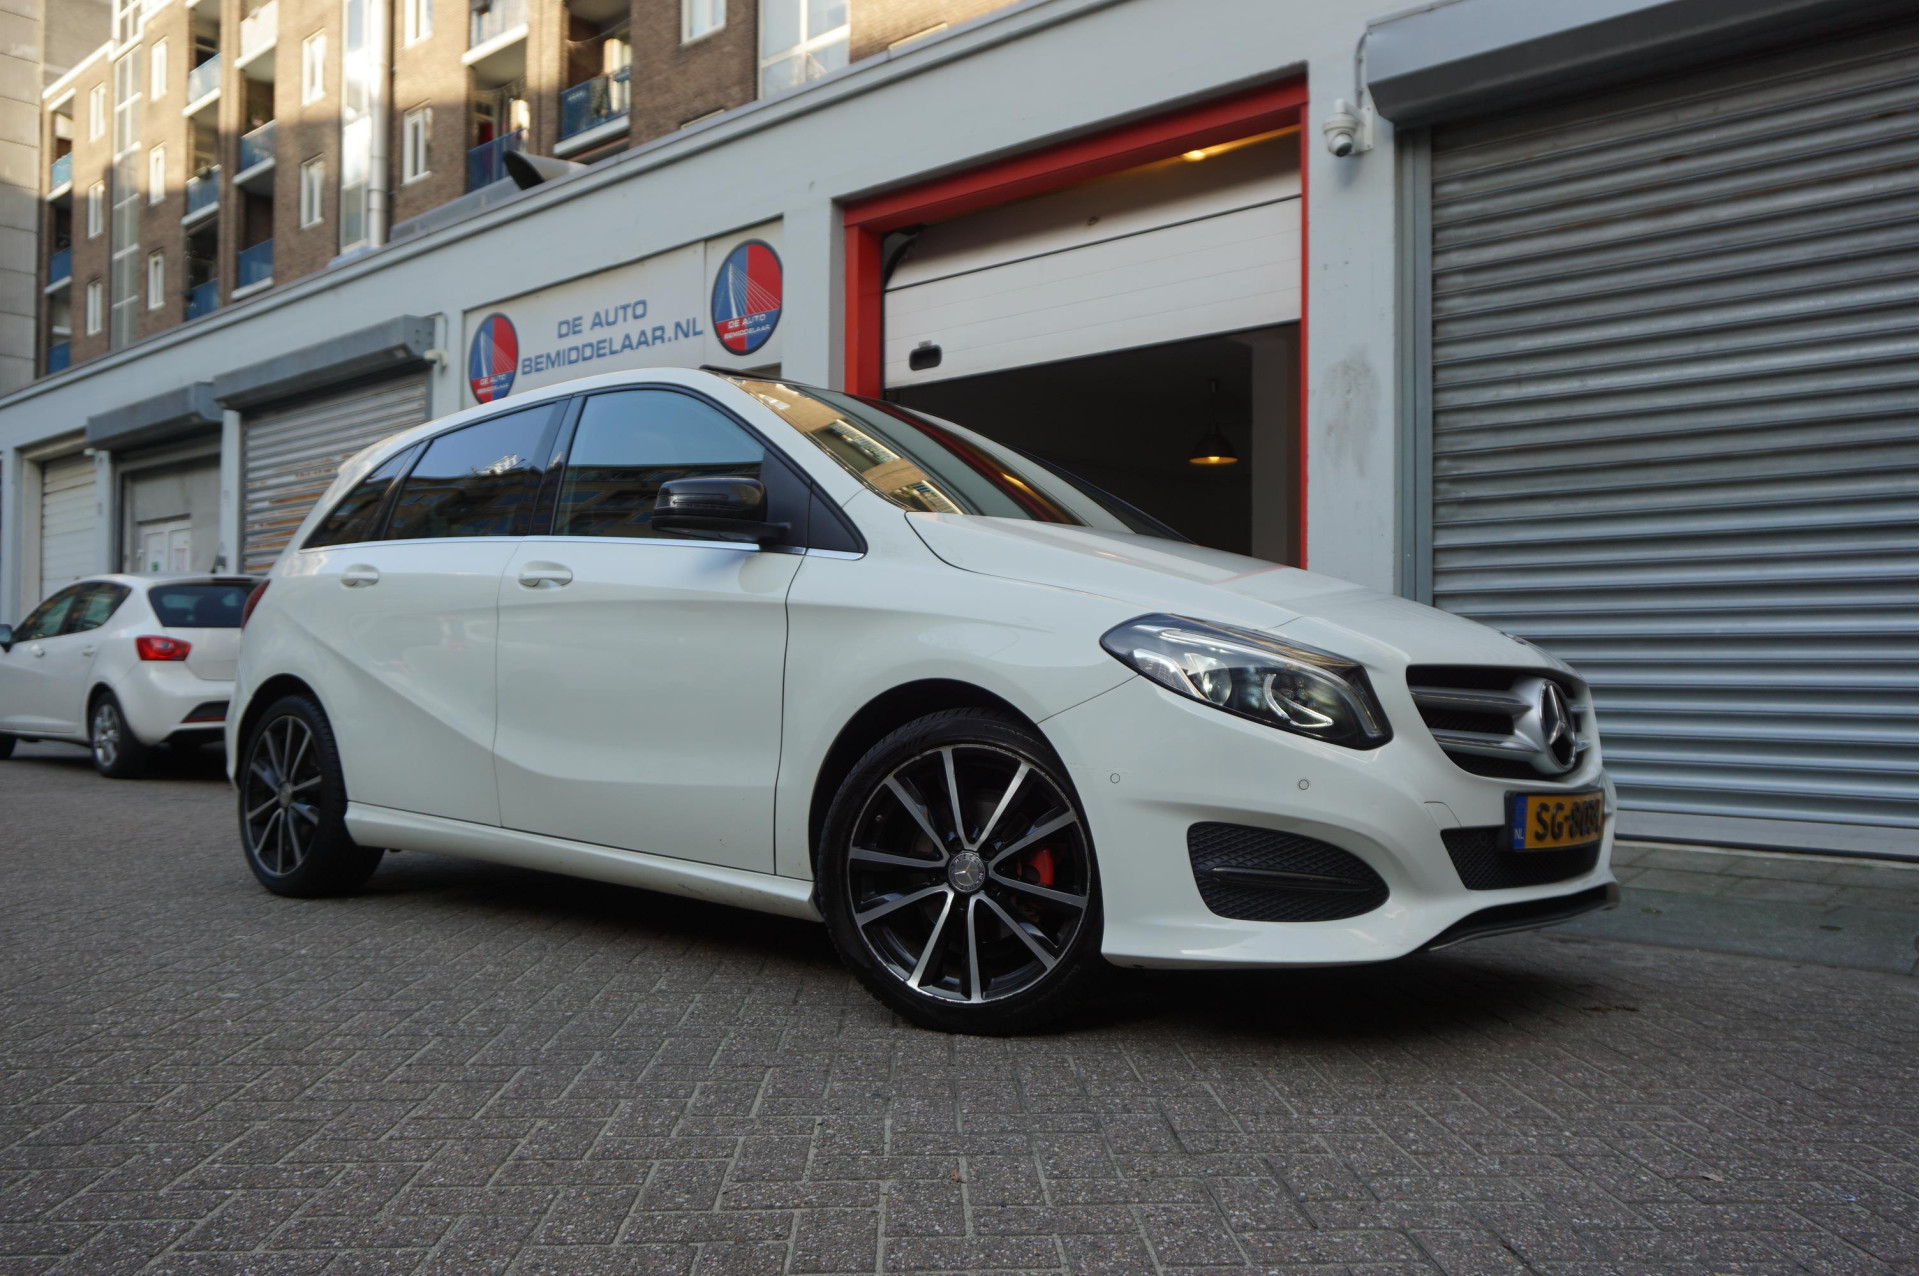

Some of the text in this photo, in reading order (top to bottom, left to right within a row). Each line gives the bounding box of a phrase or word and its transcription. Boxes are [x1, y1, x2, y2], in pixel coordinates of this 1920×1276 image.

[557, 299, 647, 339] DE AUTO
[728, 313, 766, 329] DE AUTO
[521, 317, 704, 376] BEMIDDELAAR.NL
[1514, 828, 1525, 840] NL
